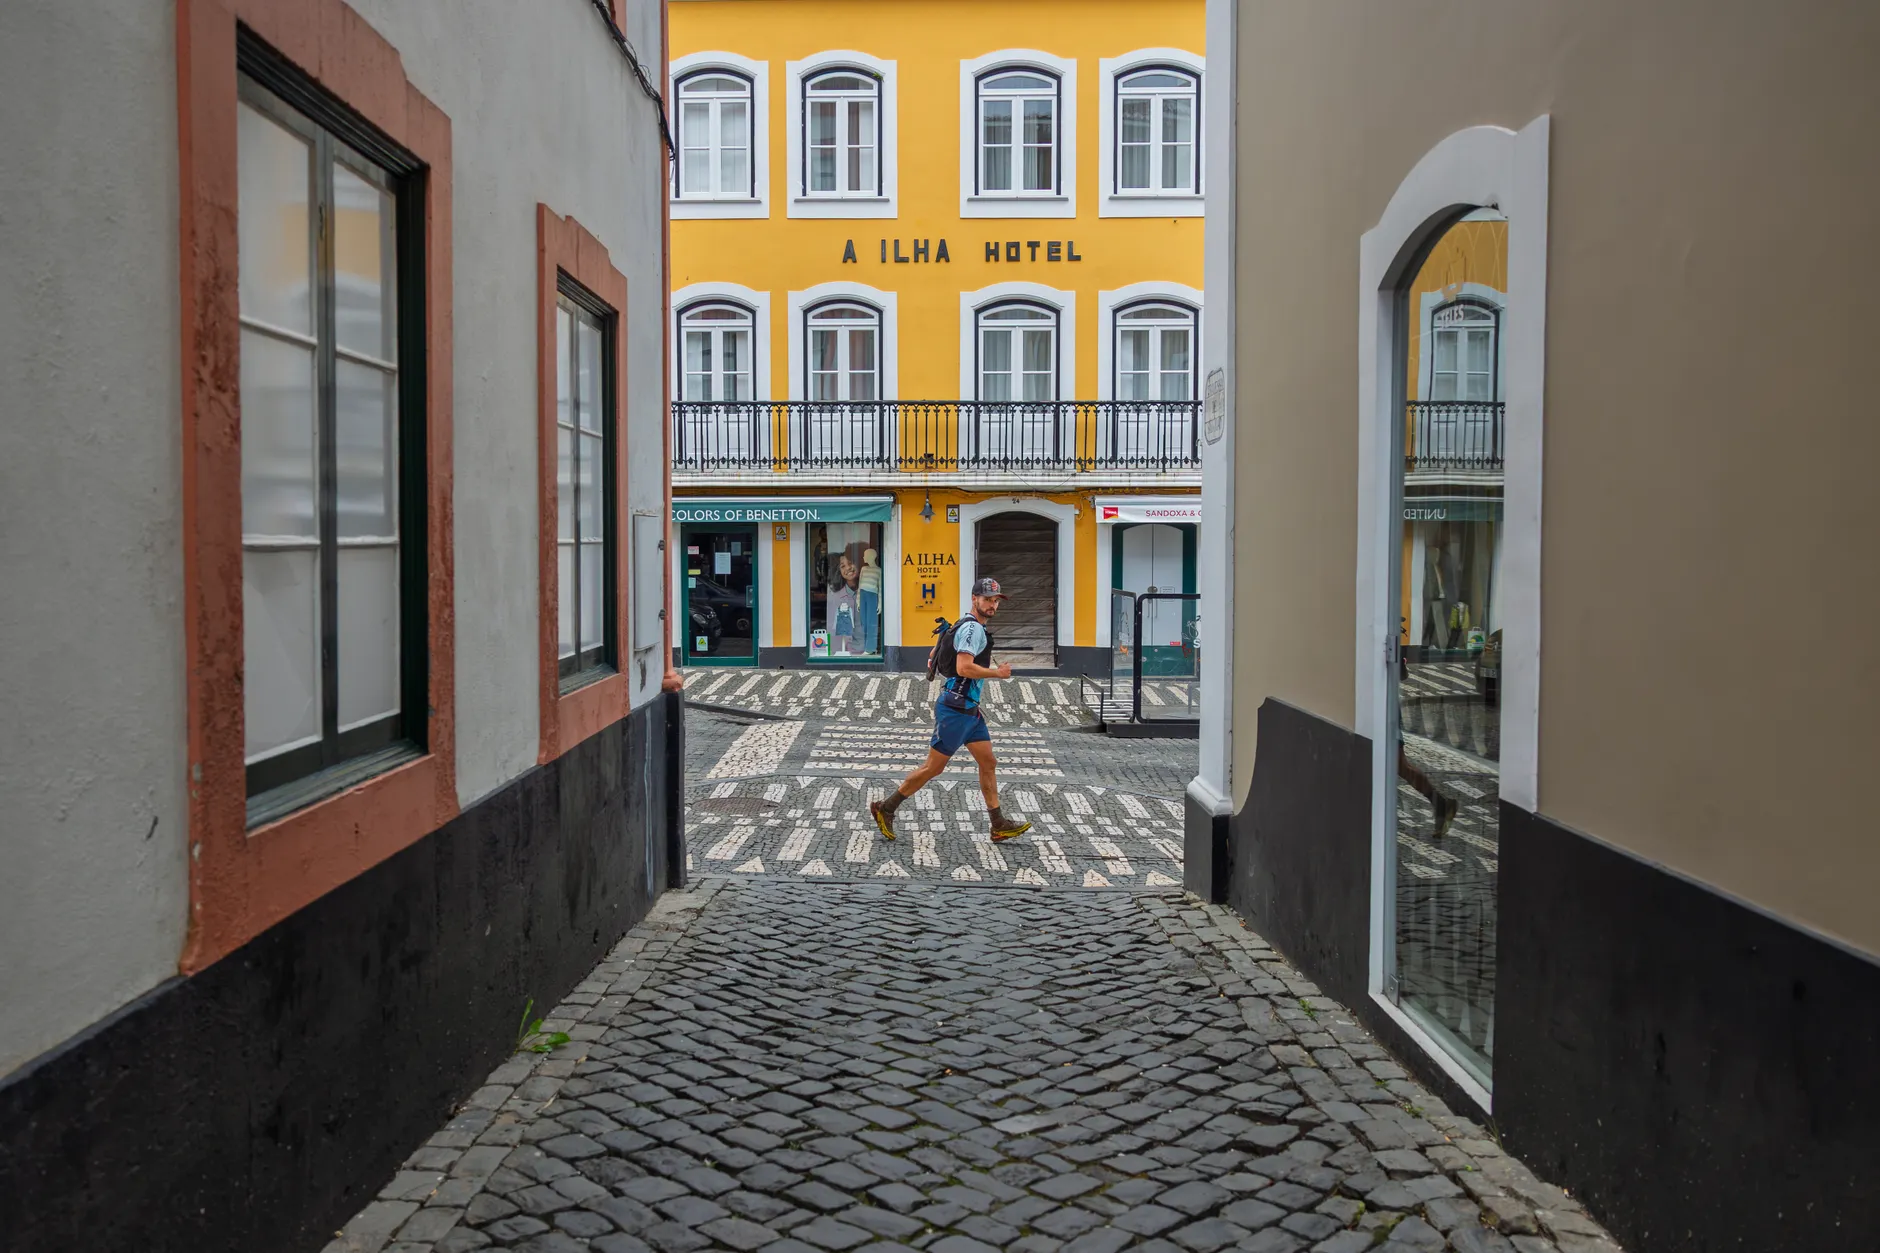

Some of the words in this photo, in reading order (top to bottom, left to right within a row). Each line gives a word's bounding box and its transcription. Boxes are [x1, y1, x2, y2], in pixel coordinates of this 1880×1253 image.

[842, 239, 857, 263] A
[880, 239, 950, 263] ILHA
[985, 240, 1082, 262] HOTEL
[724, 509, 743, 521] OF
[903, 553, 915, 565] A
[917, 553, 957, 565] ILHA
[922, 583, 936, 599] H
